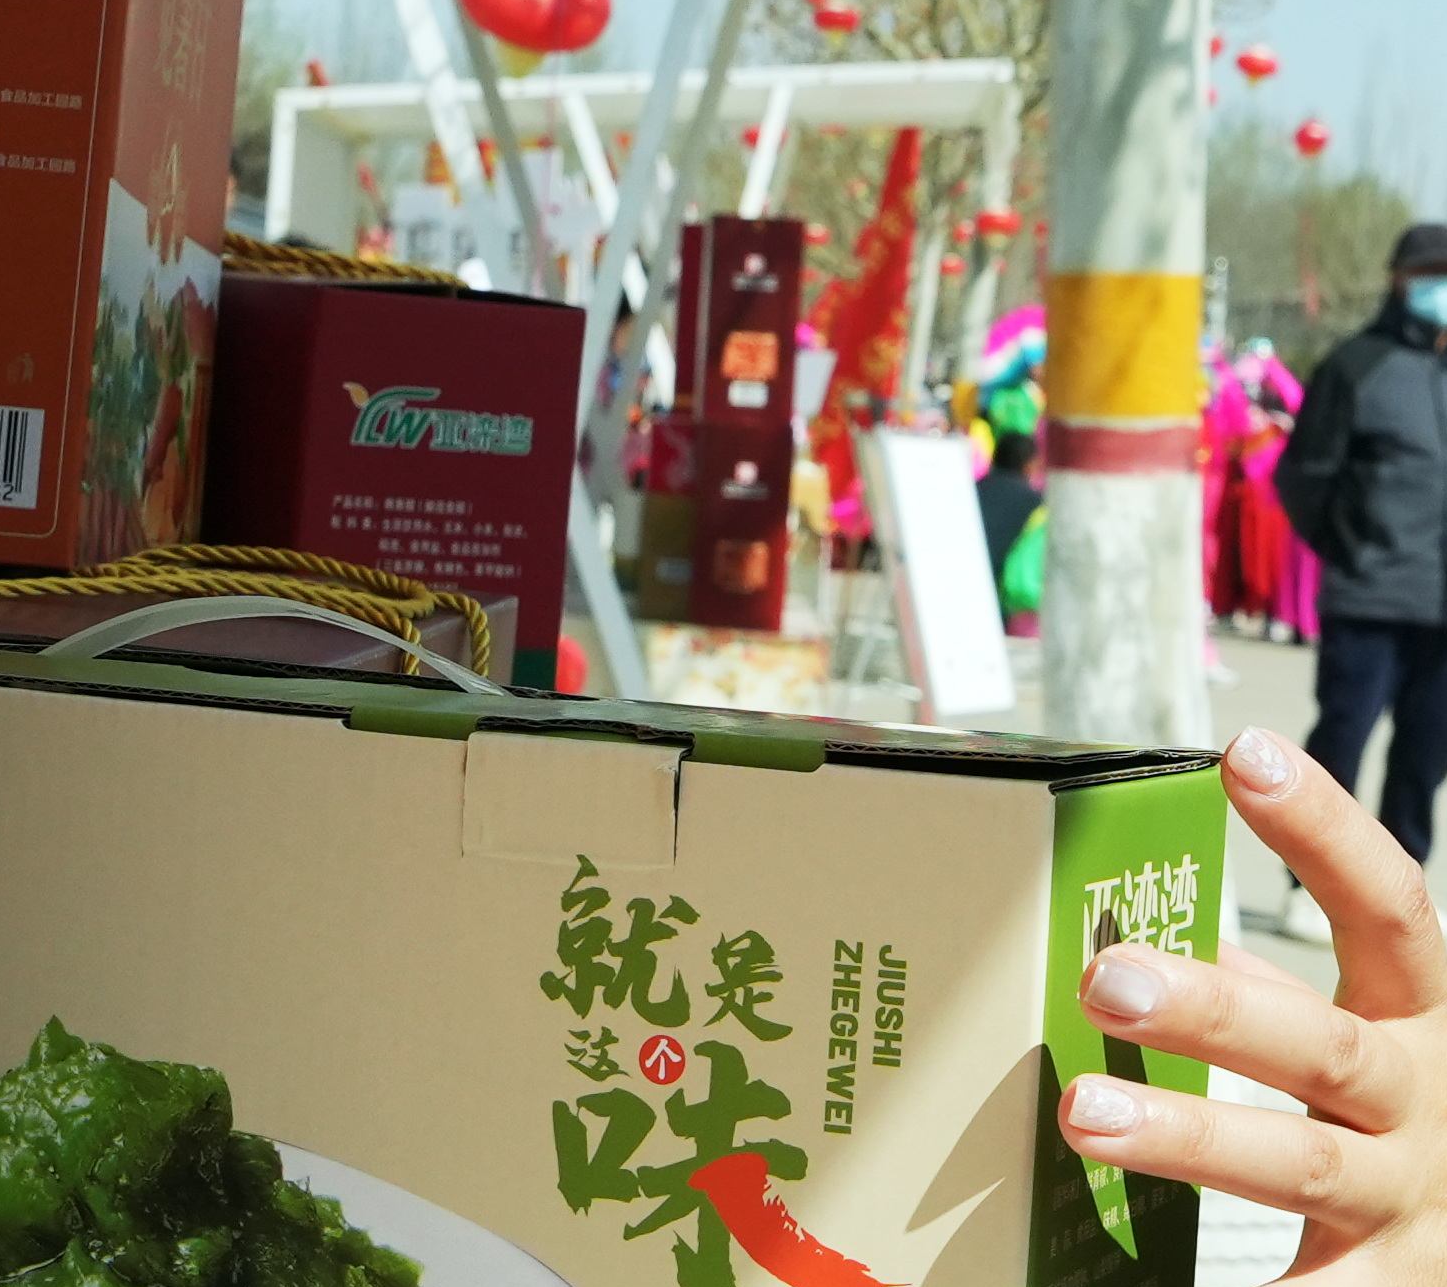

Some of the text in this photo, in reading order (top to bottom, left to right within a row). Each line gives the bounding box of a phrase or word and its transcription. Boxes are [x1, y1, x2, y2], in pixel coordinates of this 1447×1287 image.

[539, 854, 794, 1042] 就是
[872, 943, 907, 1068] JIUSHI
[564, 1026, 686, 1086] 这个
